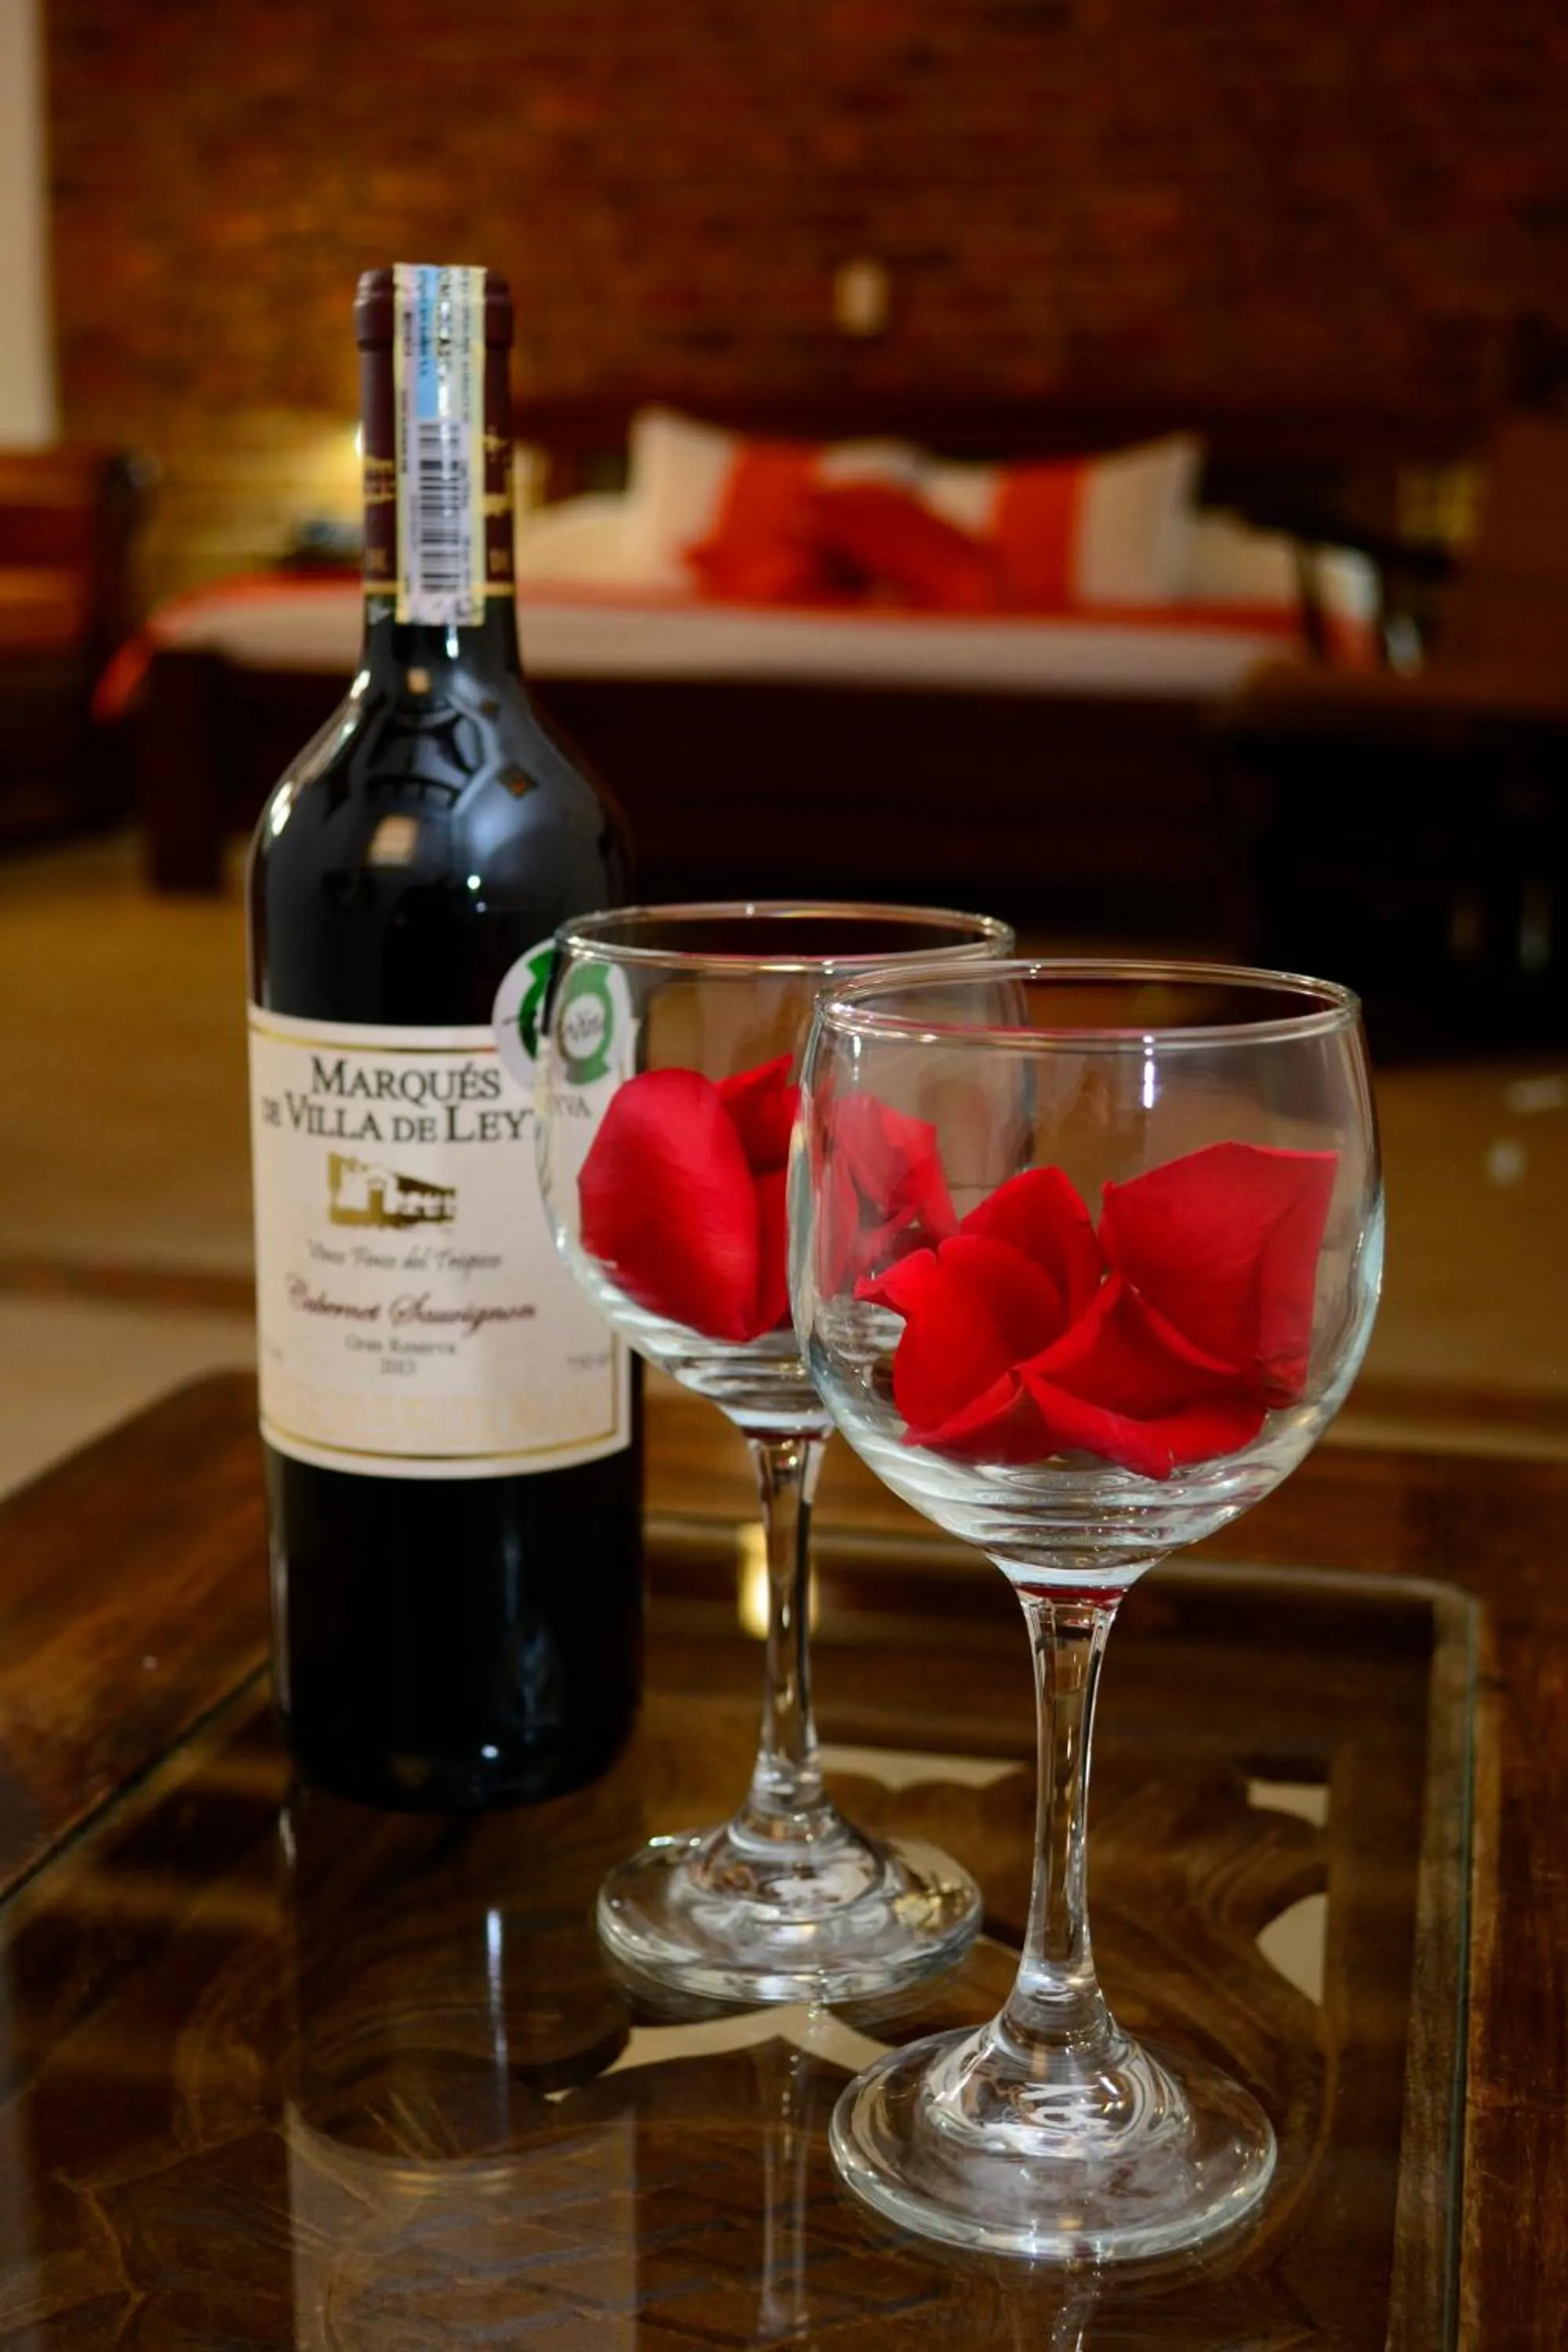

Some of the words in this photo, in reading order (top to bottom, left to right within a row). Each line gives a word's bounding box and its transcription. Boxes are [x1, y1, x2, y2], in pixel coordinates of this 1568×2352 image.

[311, 1055, 503, 1104] MARQUÉS
[285, 1092, 383, 1142] VILLA
[392, 1116, 436, 1142] DE
[284, 1271, 381, 1321] Cabernet
[389, 1292, 536, 1338] Sauvignon
